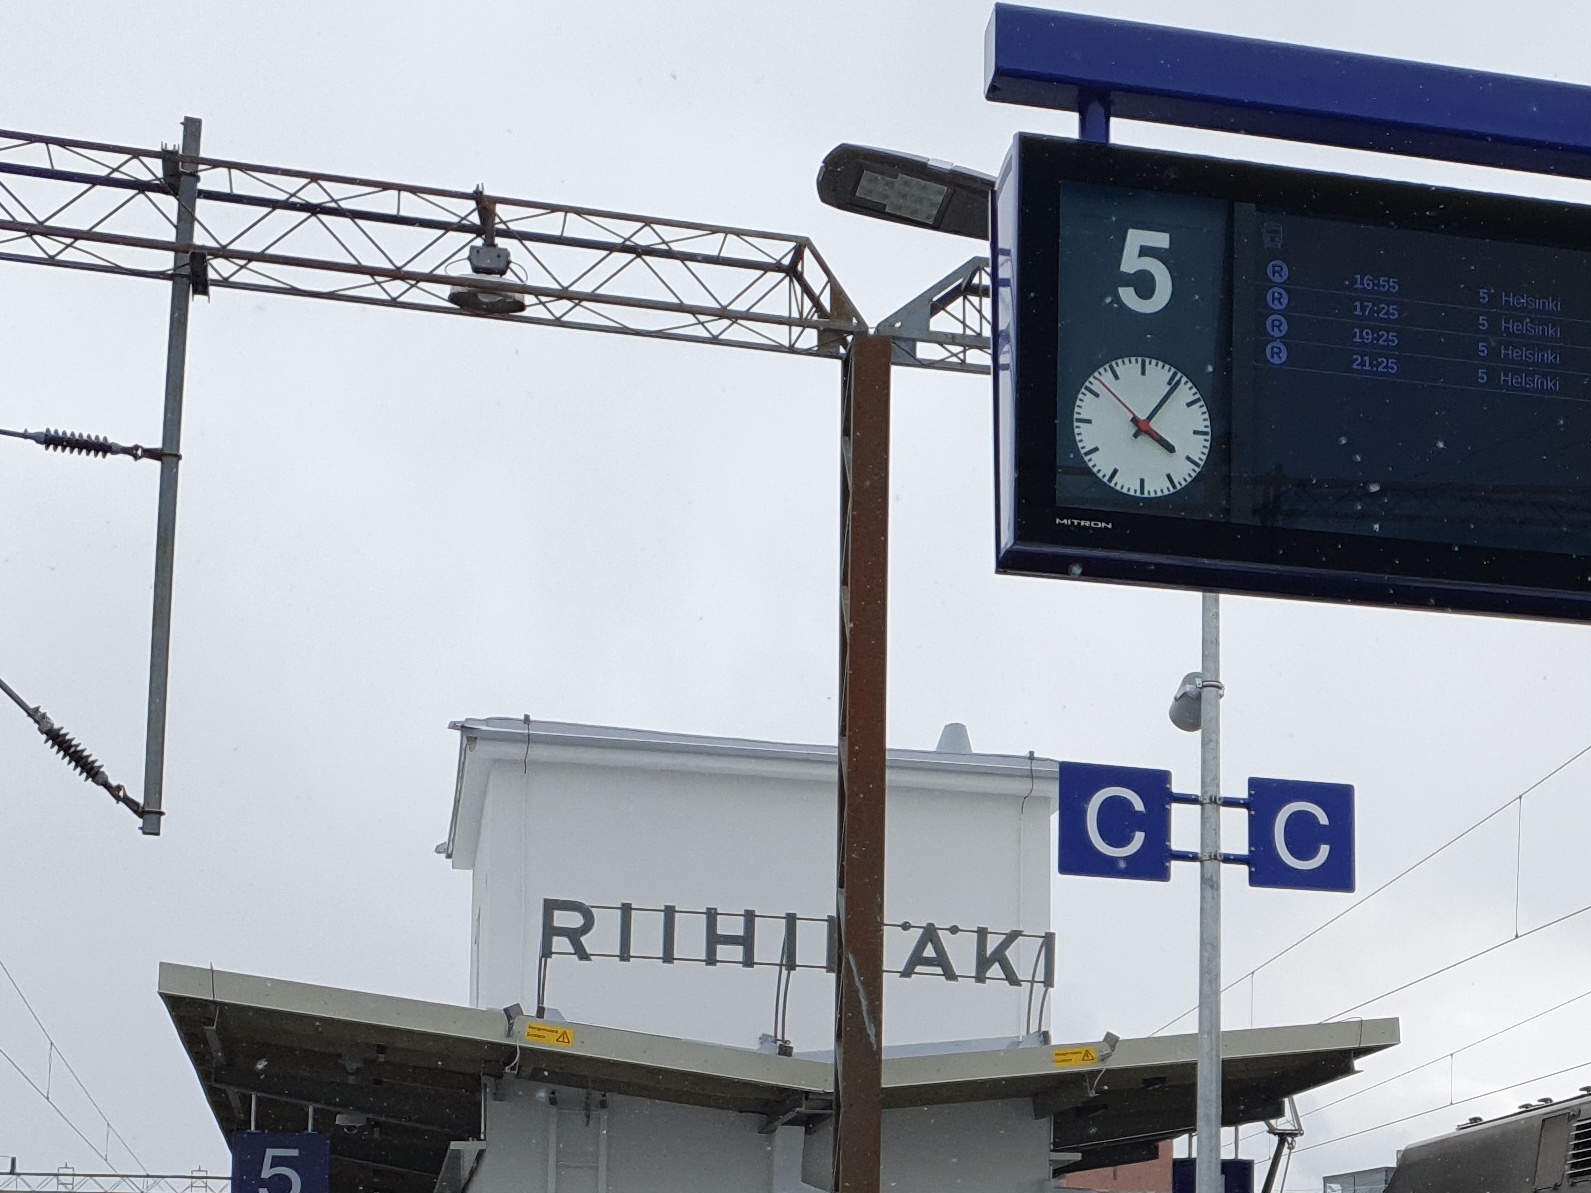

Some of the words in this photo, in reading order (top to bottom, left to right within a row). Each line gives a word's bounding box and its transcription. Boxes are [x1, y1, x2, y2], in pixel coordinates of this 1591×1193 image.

[1118, 229, 1172, 313] 5
[1353, 274, 1399, 293] 16:55
[1479, 289, 1489, 304] 5
[1501, 291, 1562, 312] Helsinki
[1353, 301, 1399, 320] 17:25
[1478, 316, 1489, 330] 5
[1501, 318, 1561, 338] Helsinki
[1352, 328, 1399, 346] 19:25
[1478, 343, 1488, 357] 5
[1500, 345, 1561, 365] Helsinki
[1352, 355, 1398, 374] 21:25
[1477, 369, 1488, 383] 5
[1500, 371, 1560, 391] Helsinki
[1055, 518, 1113, 529] MITRON
[1087, 786, 1146, 857] C
[1274, 801, 1330, 870] C
[542, 898, 1056, 988] RIIHIÄKI
